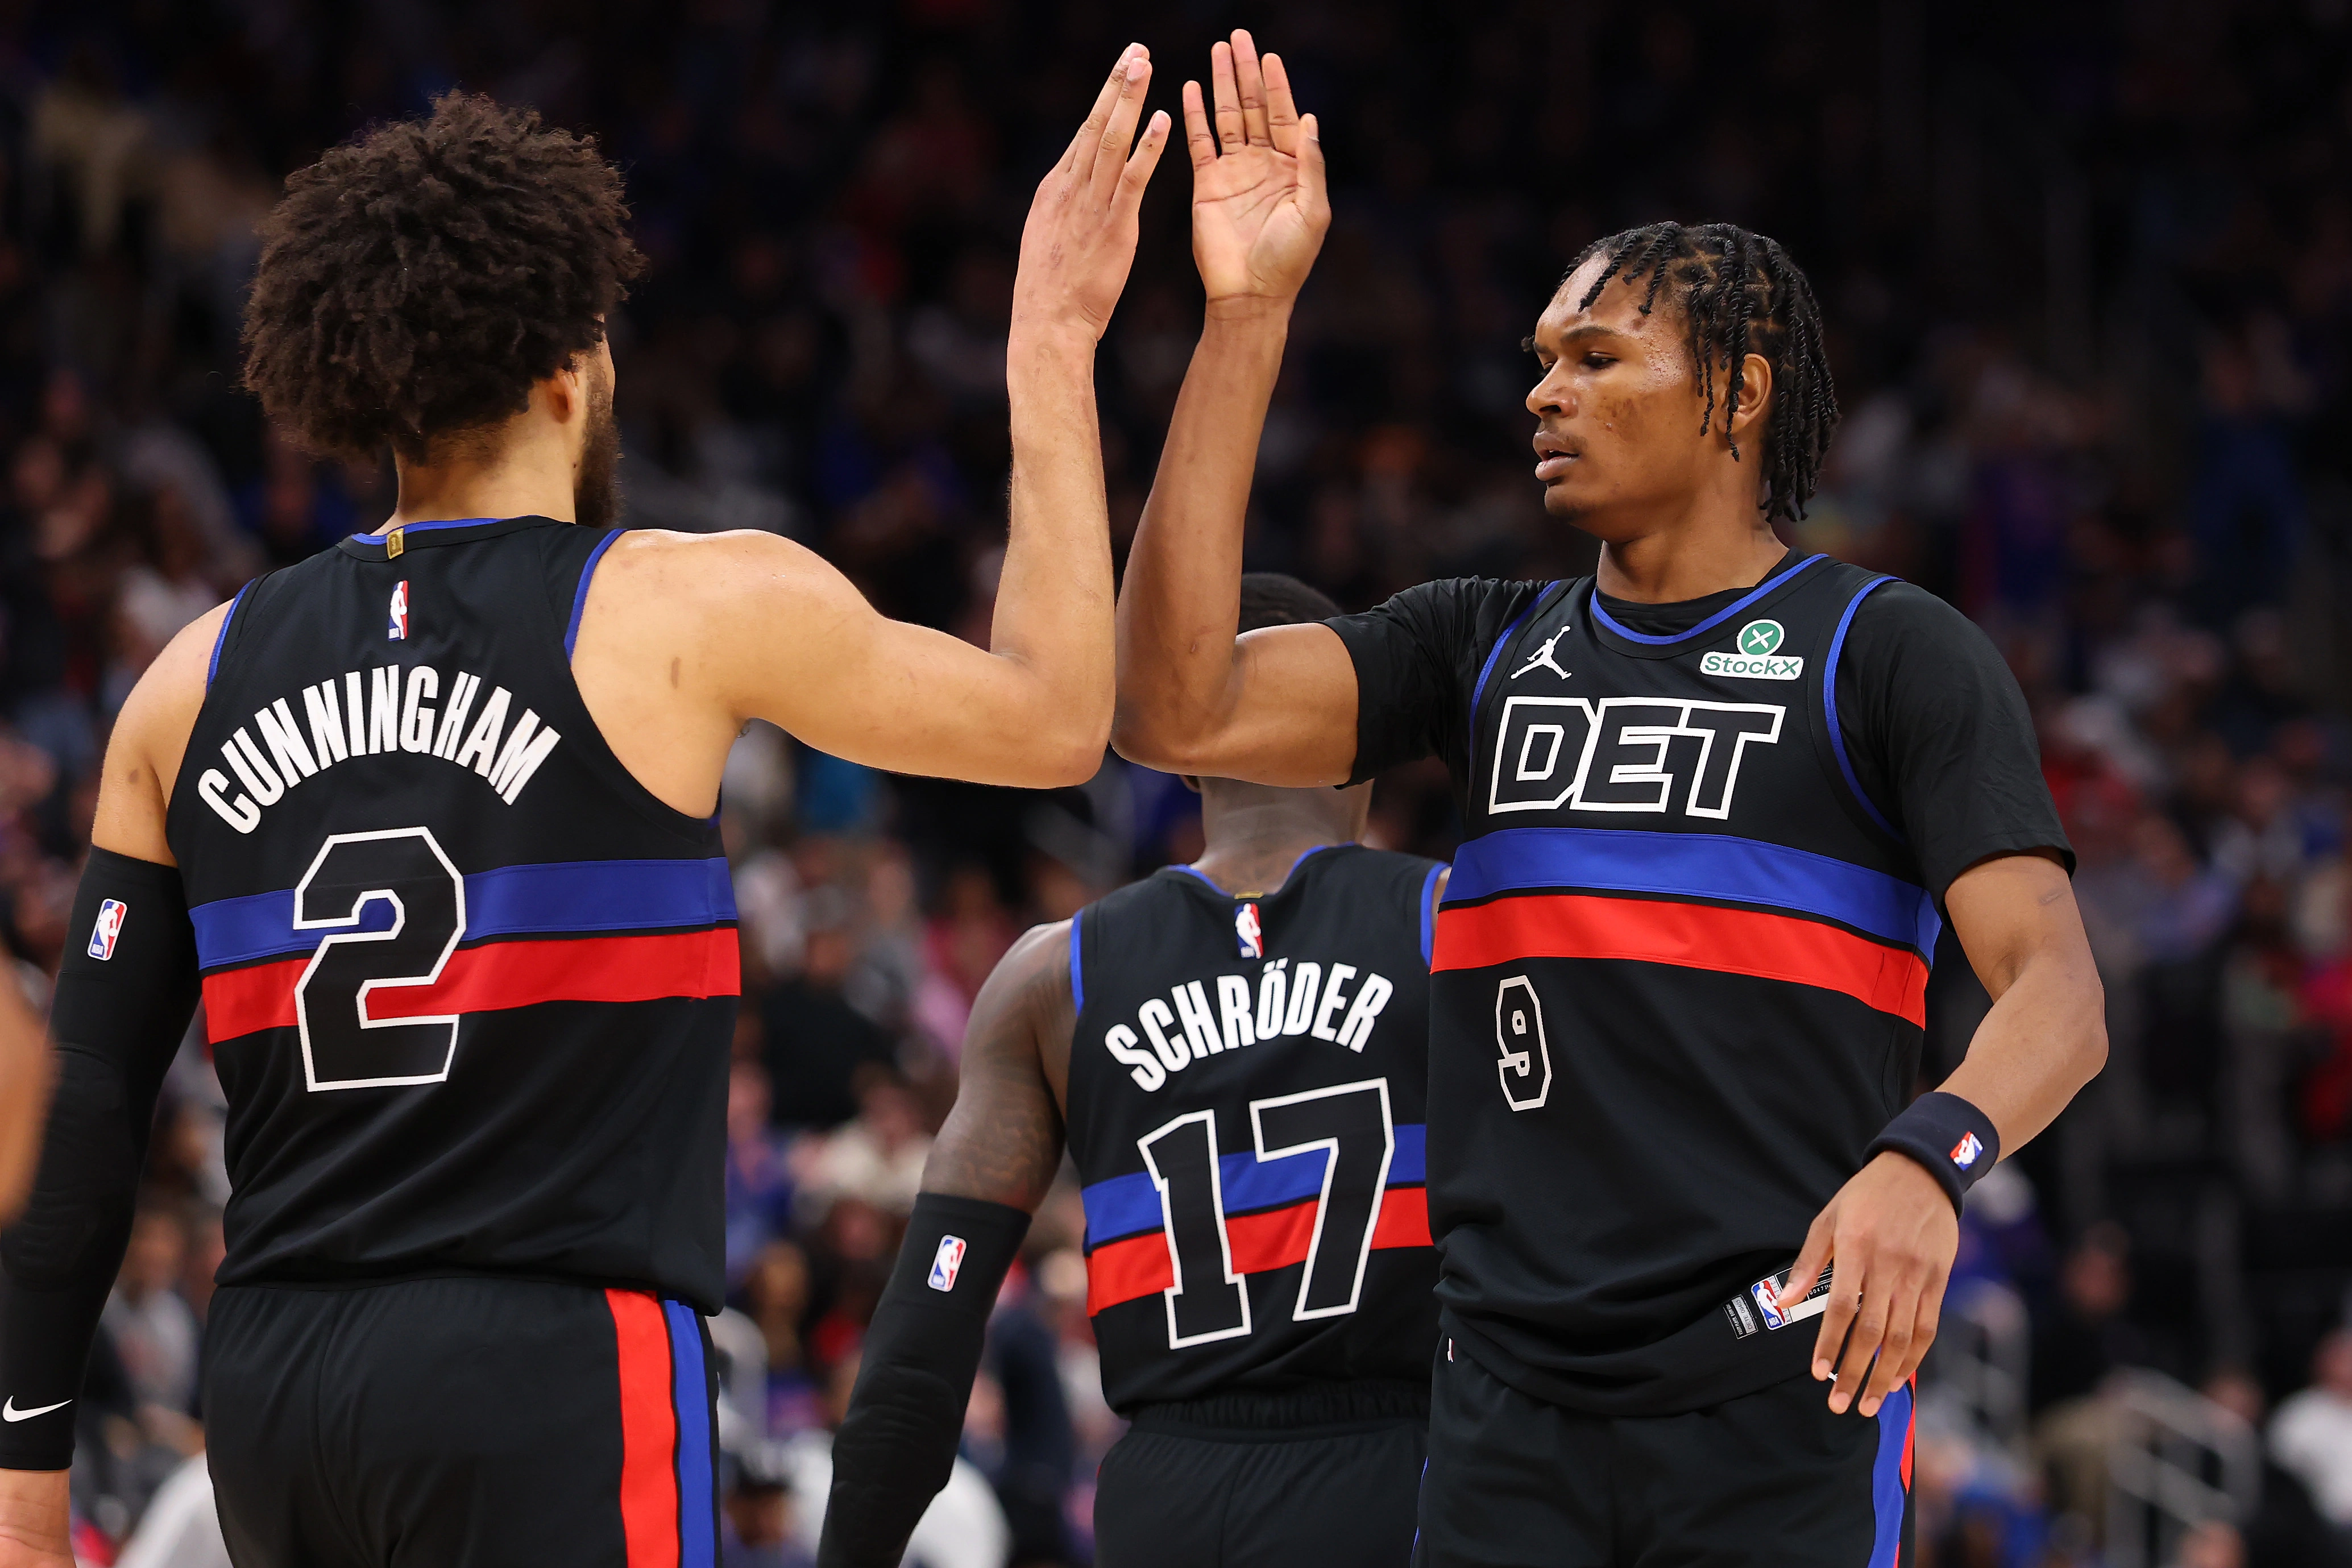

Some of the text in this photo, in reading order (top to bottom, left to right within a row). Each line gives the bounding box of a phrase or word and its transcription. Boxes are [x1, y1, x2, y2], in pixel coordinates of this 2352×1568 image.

[1705, 656, 1799, 676] StockX
[197, 663, 562, 834] CUNNINGHAM
[1488, 696, 1786, 820] DET
[293, 826, 467, 1092] 2
[1104, 957, 1393, 1093] SCHRÖDER
[1495, 974, 1552, 1111] 9
[1137, 1077, 1395, 1350] 17
[1768, 1315, 1779, 1326] NBA
[1770, 1276, 1790, 1322] AUTNTICS
